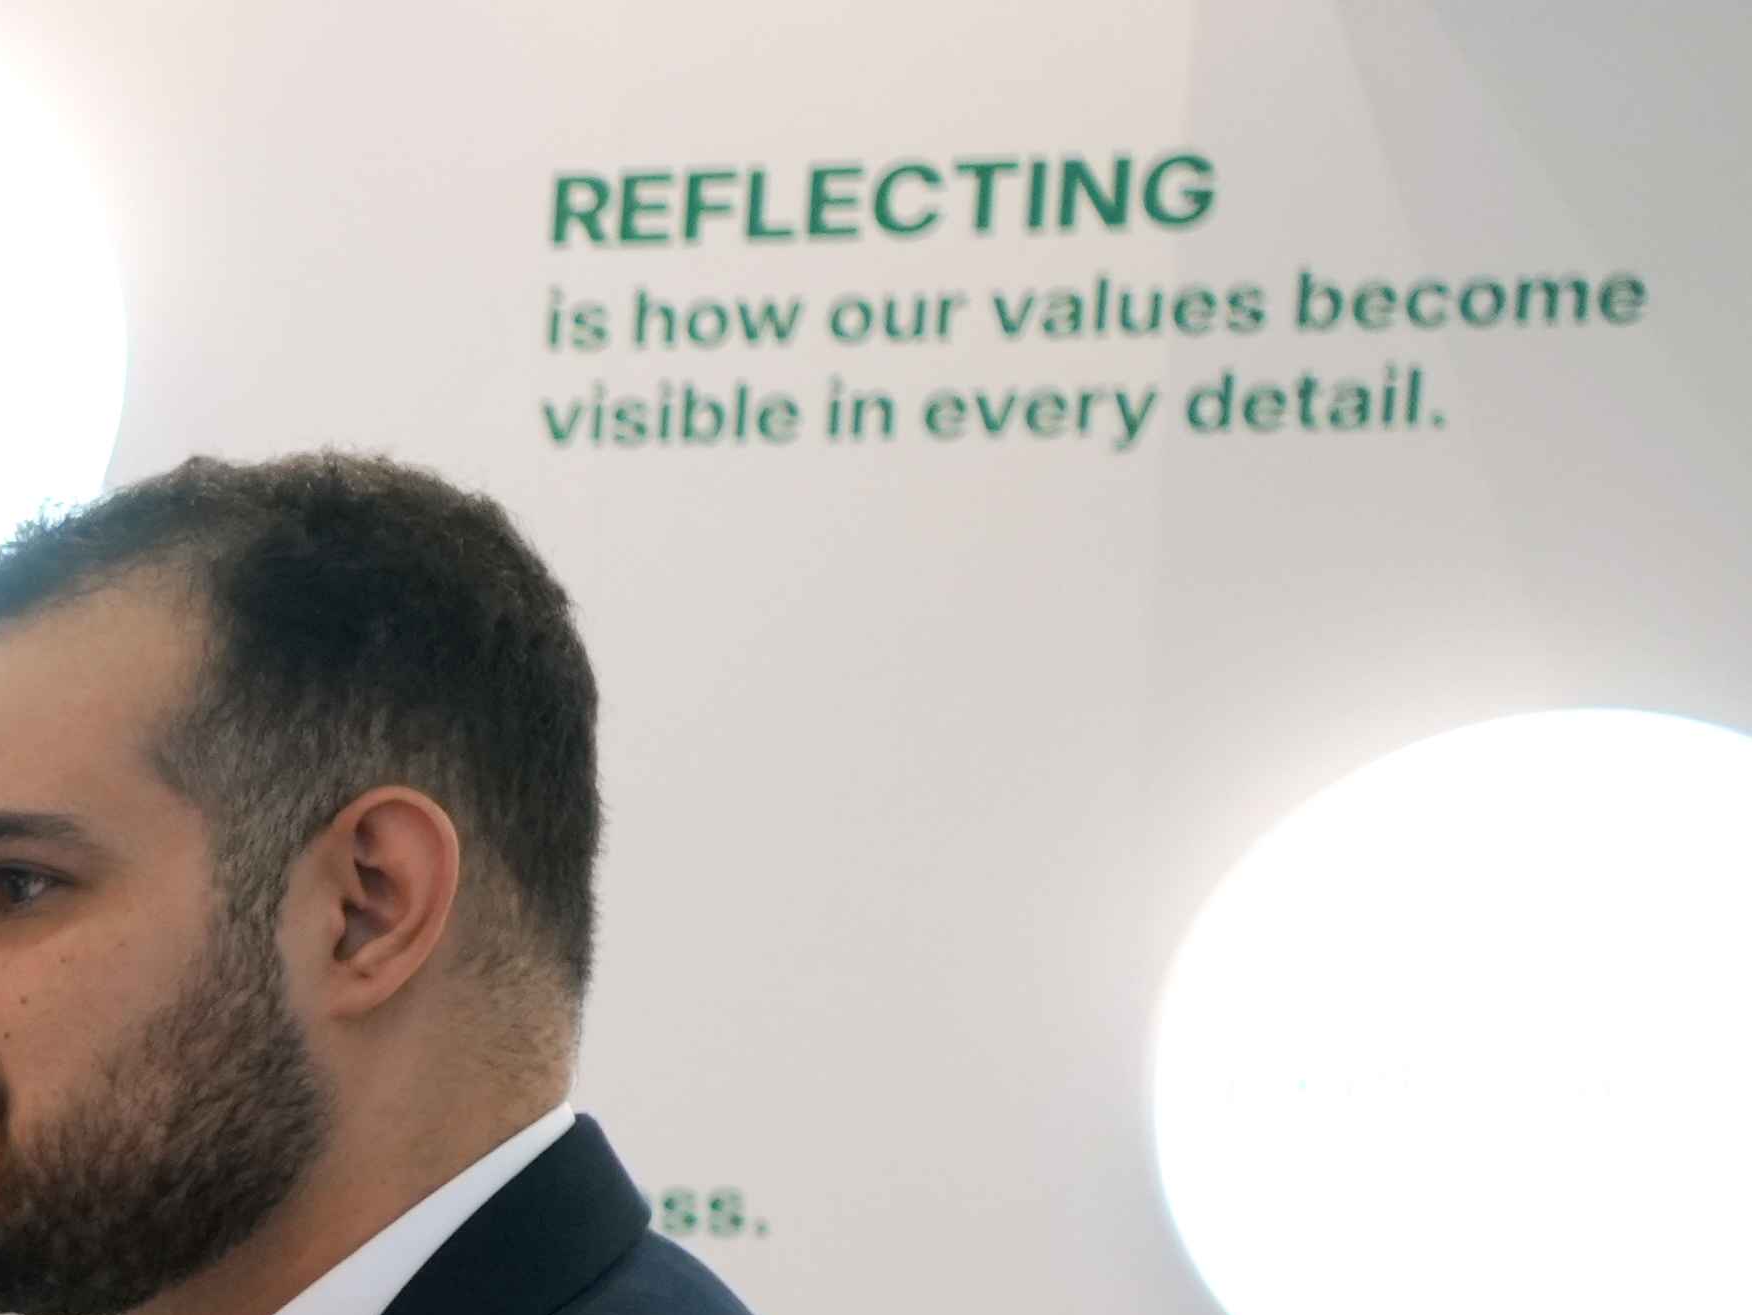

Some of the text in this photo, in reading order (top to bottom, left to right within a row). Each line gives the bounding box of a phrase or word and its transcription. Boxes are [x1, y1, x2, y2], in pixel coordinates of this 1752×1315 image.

[550, 154, 1214, 244] REFLECTING
[548, 268, 1646, 349] is how our values become
[543, 364, 1446, 451] visible in every detail.
